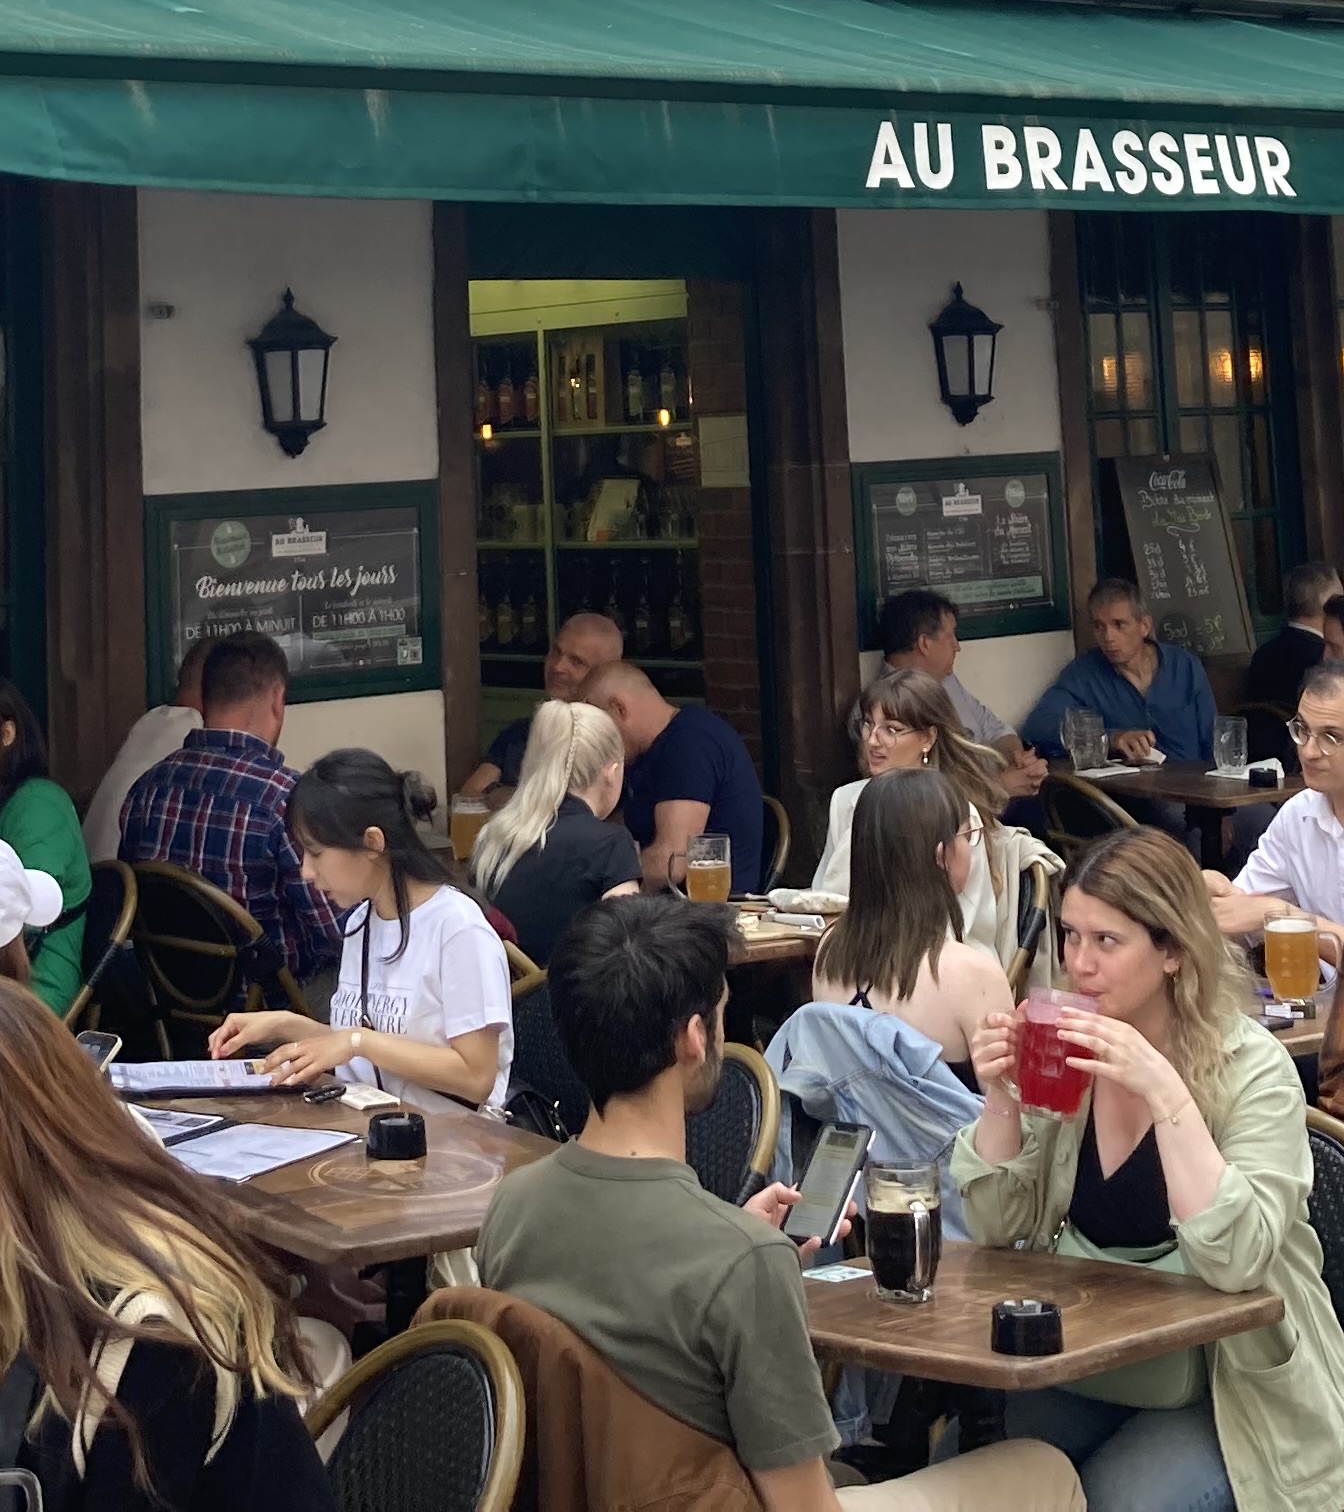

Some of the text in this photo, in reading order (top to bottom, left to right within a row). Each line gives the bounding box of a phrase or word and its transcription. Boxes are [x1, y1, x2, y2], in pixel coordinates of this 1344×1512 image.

[865, 121, 1298, 197] AU BRASSEUR
[196, 565, 398, 599] Bienvenue tous les jours
[185, 626, 202, 639] DE
[256, 616, 296, 632] MINUIT
[312, 615, 327, 628] DE
[331, 611, 366, 626] 11H00
[379, 607, 406, 622] 1H00
[367, 993, 408, 1016] NERGY
